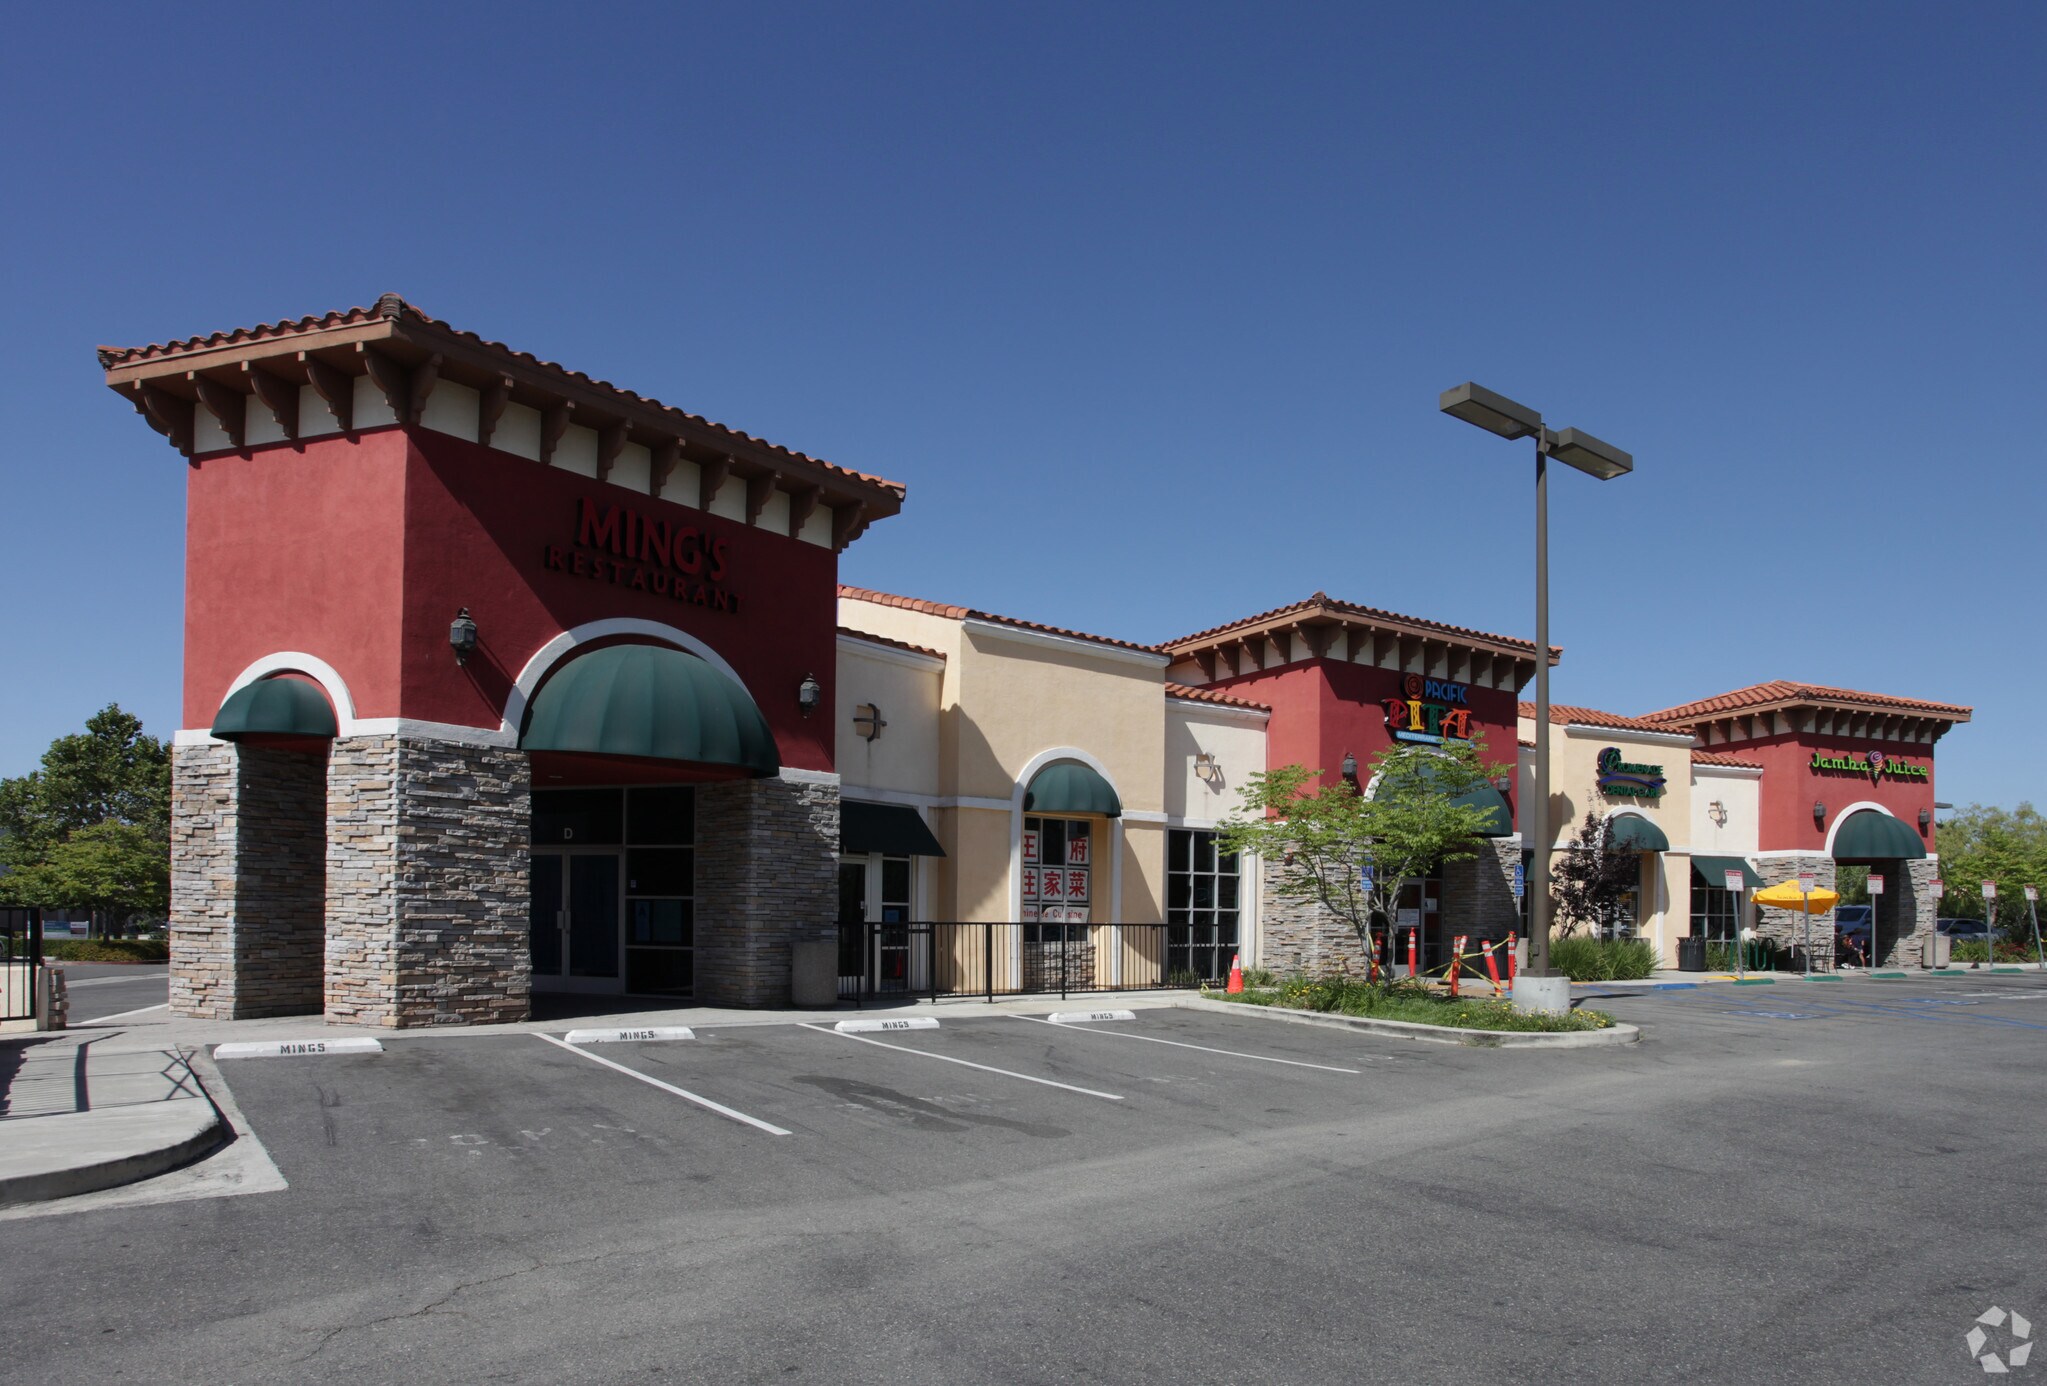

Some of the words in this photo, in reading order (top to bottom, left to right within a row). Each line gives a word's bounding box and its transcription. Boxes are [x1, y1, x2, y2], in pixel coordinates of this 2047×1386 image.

[576, 496, 729, 581] MING'S
[546, 544, 745, 613] RESTAURANT
[1425, 680, 1468, 704] PACIFIC
[1381, 697, 1472, 741] PITA
[1601, 750, 1664, 775] PROMENADE
[1812, 752, 1870, 771] Jamba
[1885, 758, 1928, 776] Juice
[1606, 784, 1636, 796] DENTAL
[1637, 786, 1661, 798] CARE
[563, 827, 573, 839] D
[1052, 908, 1083, 919] Cusine
[1090, 1012, 1114, 1021] MINGS
[881, 1020, 910, 1030] MINGS
[619, 1030, 655, 1041] MINGS
[280, 1043, 326, 1055] MINGS
